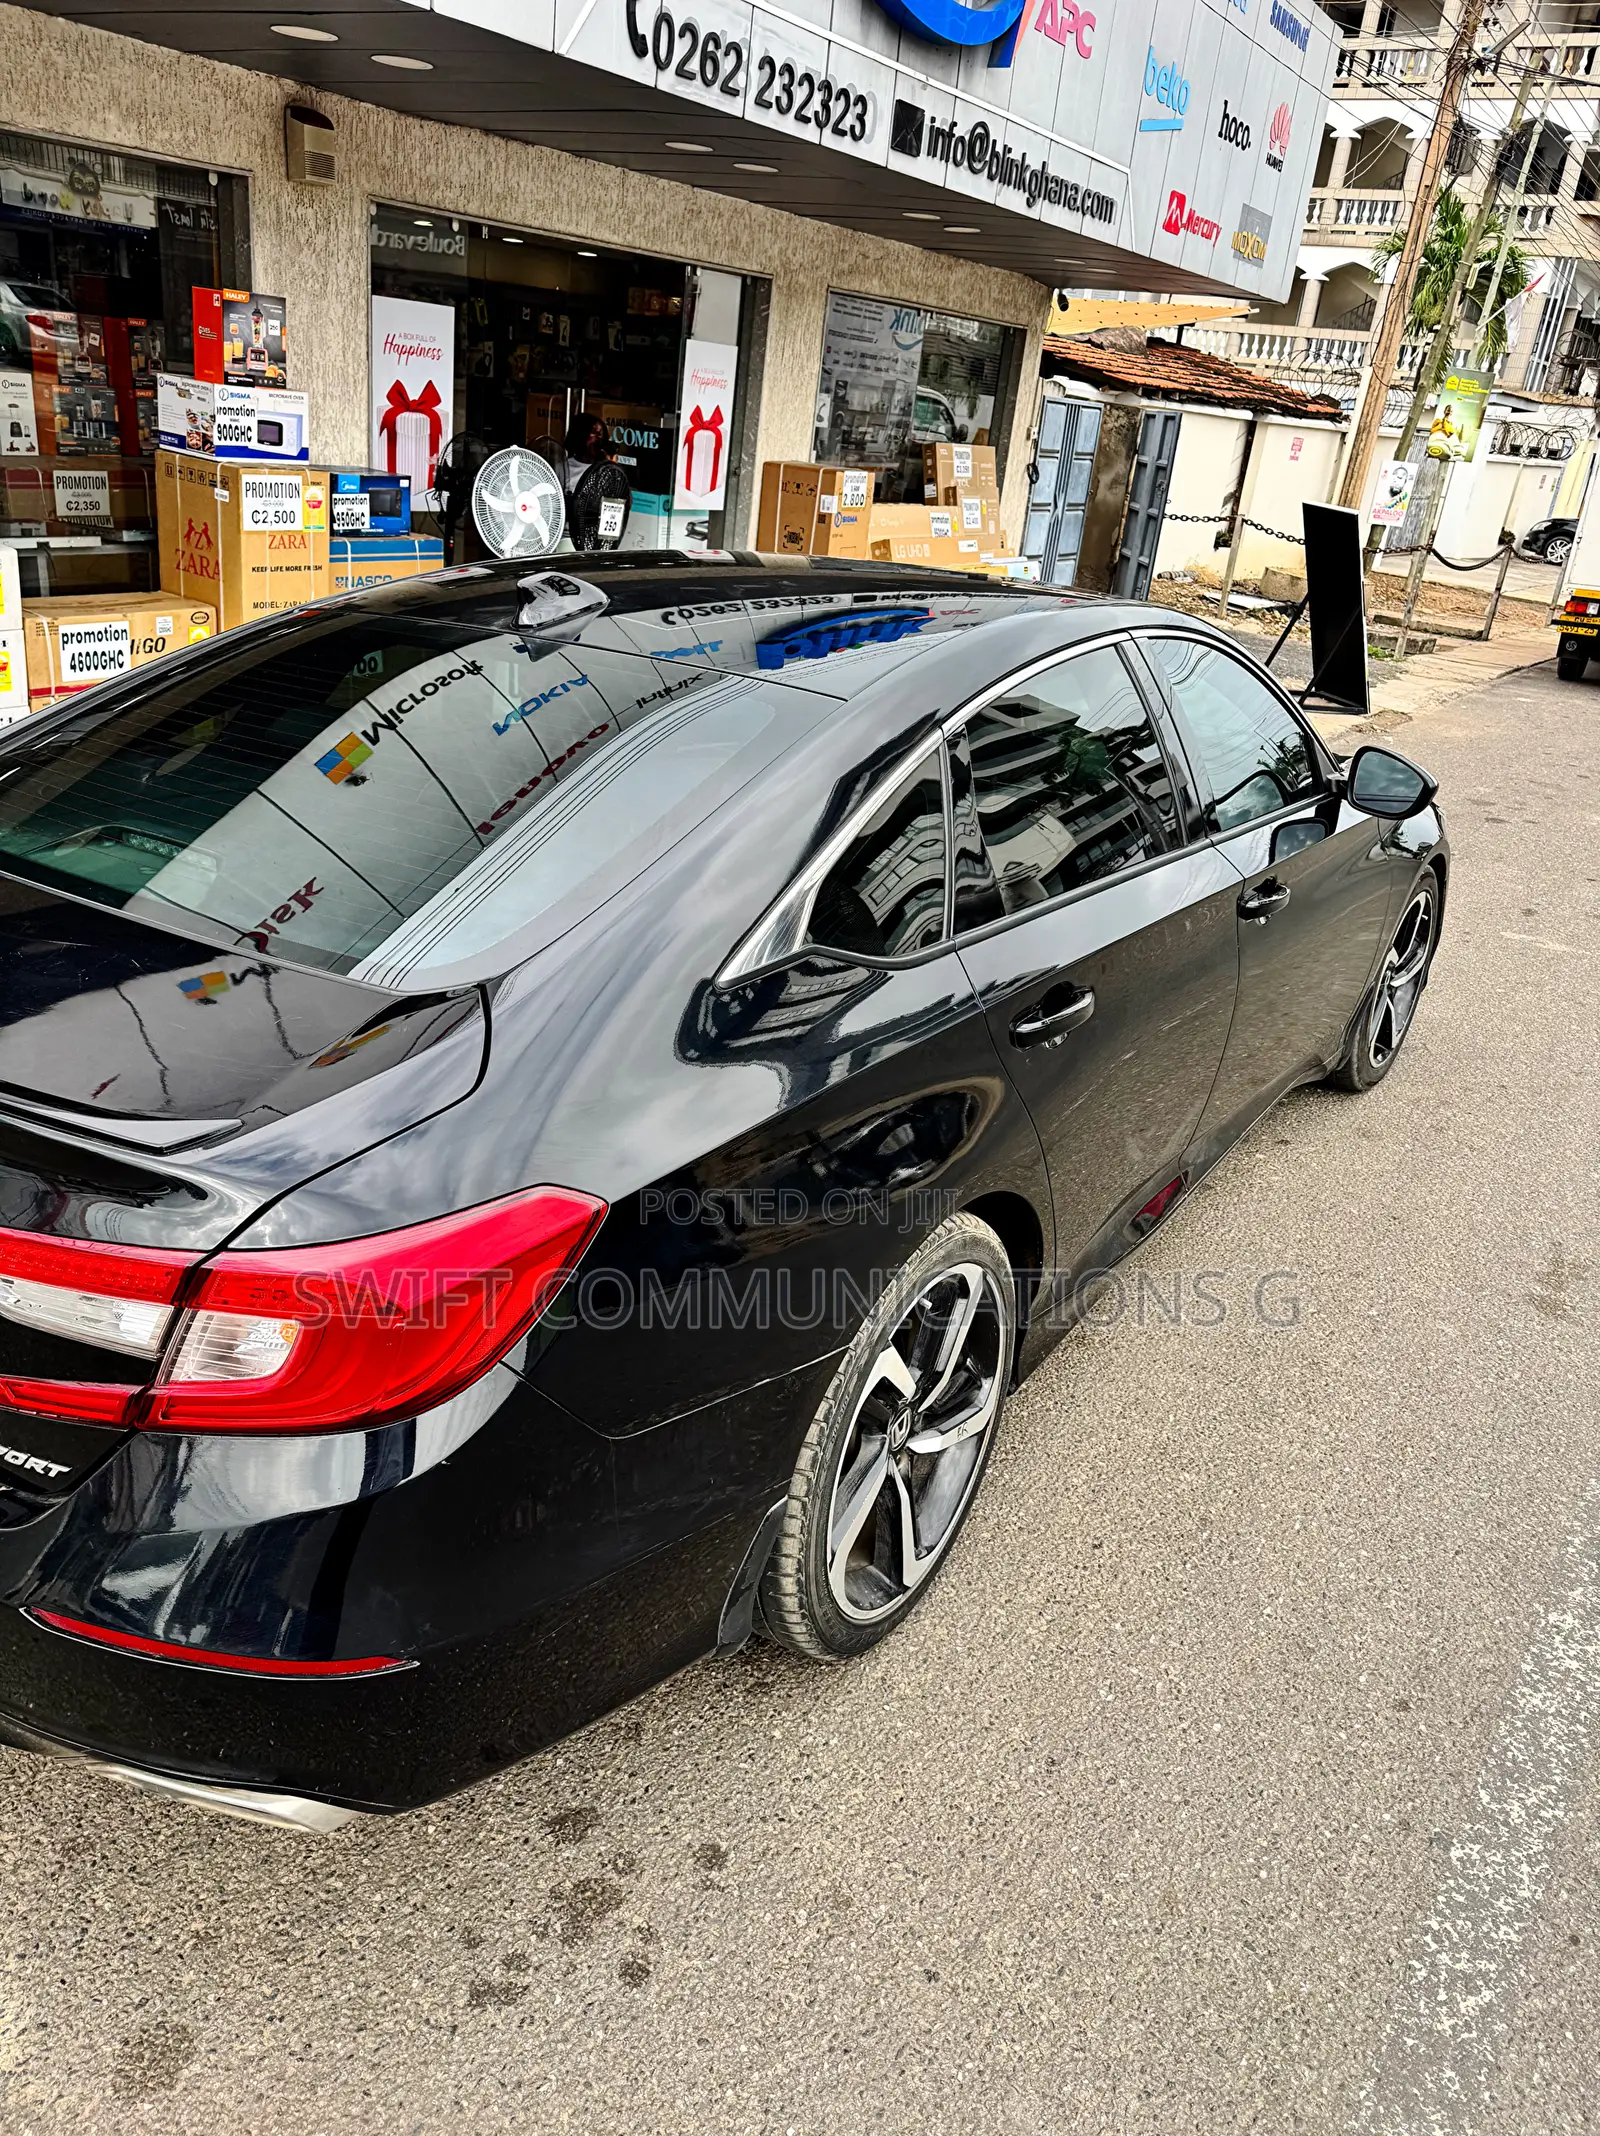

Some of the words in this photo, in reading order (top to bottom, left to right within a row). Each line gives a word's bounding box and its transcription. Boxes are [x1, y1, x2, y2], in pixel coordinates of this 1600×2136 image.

[1033, 0, 1097, 59] APC
[1269, 0, 1311, 53] SAMSUNG
[652, 11, 744, 97] 0262
[754, 55, 868, 142] 232323
[1144, 45, 1191, 116] beko
[926, 115, 1117, 226] info@blinkghana.com
[1184, 207, 1222, 248] Mercury
[383, 333, 444, 366] Happiness
[690, 368, 728, 394] Happiness
[229, 392, 251, 400] SIGMA
[217, 423, 252, 443] 900GHC
[613, 426, 659, 450] COME
[55, 475, 108, 490] PROMOTION
[245, 481, 301, 499] PROMOTION
[333, 494, 368, 509] promotion
[1372, 508, 1404, 518] AKPALOO
[336, 511, 366, 528] 950GHC
[604, 520, 617, 532] 250
[268, 534, 307, 550] ZARA
[895, 545, 906, 559] LG
[906, 544, 923, 558] UHD
[174, 548, 220, 580] ZARA
[61, 624, 128, 651] promotion
[69, 649, 125, 674] 4600GHC
